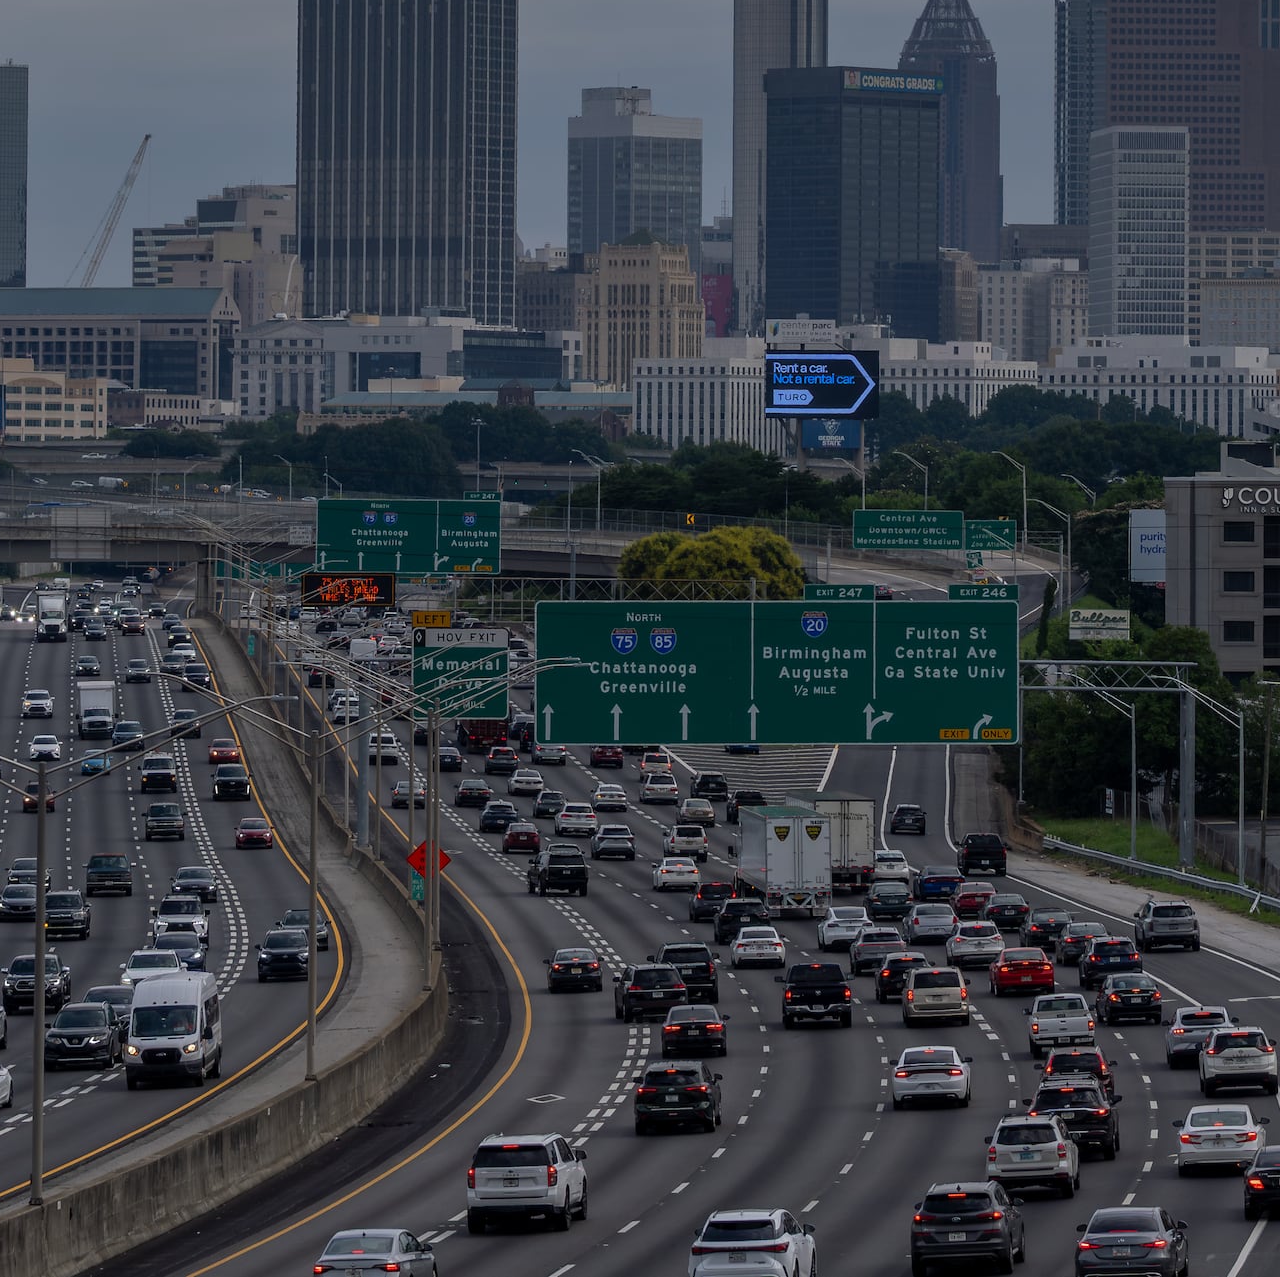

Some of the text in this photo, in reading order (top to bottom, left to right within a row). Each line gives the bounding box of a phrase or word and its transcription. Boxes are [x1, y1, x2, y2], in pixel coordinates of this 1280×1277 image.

[862, 75, 935, 91] CONGRATS GRADS!
[812, 323, 832, 332] parc
[773, 362, 829, 374] Rent a car.
[773, 373, 856, 384] Not a rental car.
[778, 393, 808, 401] TURO
[364, 515, 396, 523] 75 85
[464, 516, 474, 524] 20
[879, 514, 938, 523] Central Ave
[351, 528, 409, 539] Chattanooga
[441, 529, 497, 539] Birmingham
[869, 527, 948, 535] Downtown/GWCC
[356, 539, 403, 547] Greenville
[450, 539, 489, 549] Augusta
[856, 537, 960, 547] Mercedes-Benz Stadium
[816, 588, 863, 598] EXIT 247
[960, 588, 1007, 598] EXIT 246
[416, 614, 447, 624] LEFT
[626, 612, 662, 622] NORTH
[1071, 610, 1127, 627] Bullpen
[806, 619, 824, 632] 20
[437, 633, 462, 642] HOV
[905, 627, 987, 640] Fulton St
[615, 635, 673, 649] 75 85
[762, 646, 867, 662] Birmingham
[895, 646, 997, 659] Central Ave
[422, 658, 500, 671] Memorial
[589, 661, 697, 677] Chattanooga
[778, 666, 849, 682] Augusta
[884, 666, 1006, 679] Ga State Univ
[600, 680, 687, 694] Greenville
[813, 685, 837, 695] MILE
[943, 729, 1010, 738] EXIT ONLY
